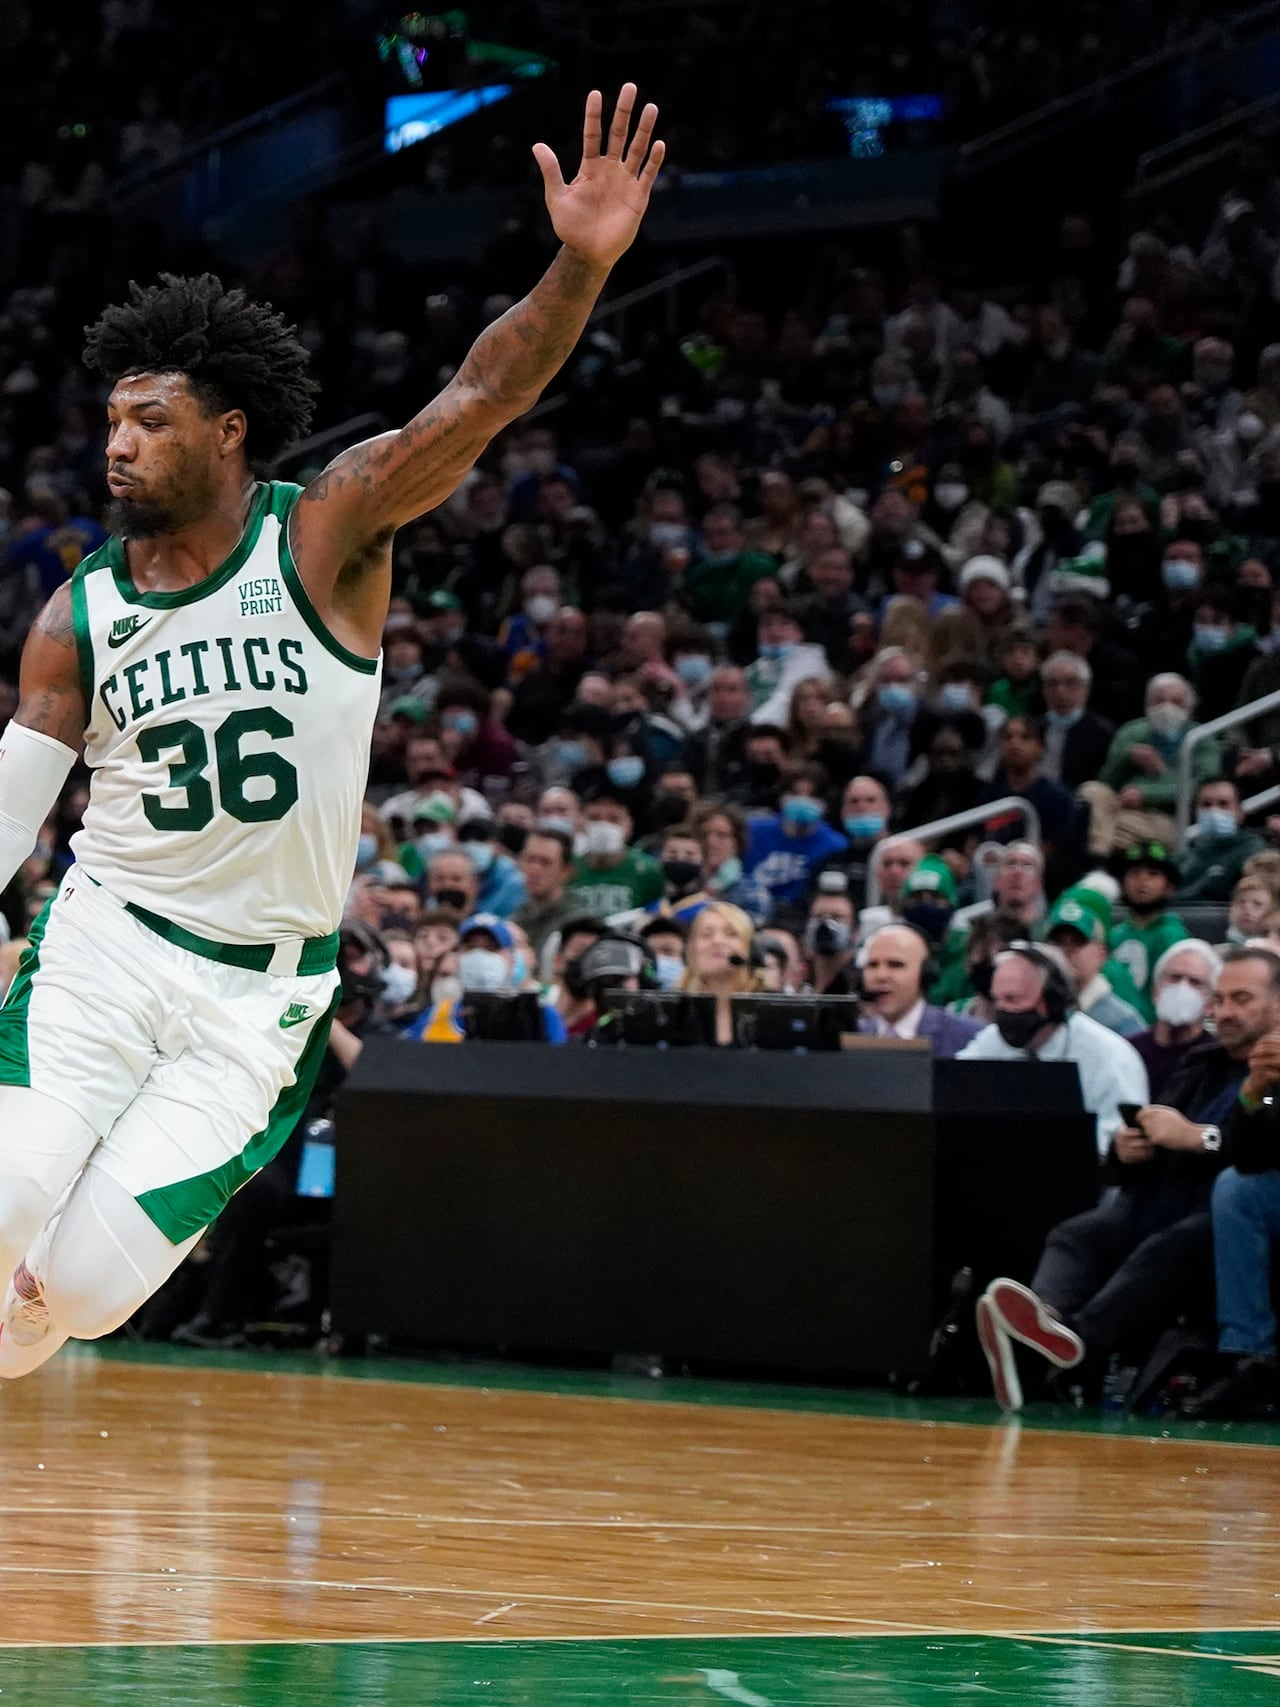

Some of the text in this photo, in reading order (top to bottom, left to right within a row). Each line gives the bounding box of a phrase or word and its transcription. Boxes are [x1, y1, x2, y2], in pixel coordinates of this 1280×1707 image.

[238, 578, 282, 600] VISTA
[240, 596, 282, 616] PRINT
[99, 637, 309, 732] CELTICS
[135, 706, 300, 832] 36
